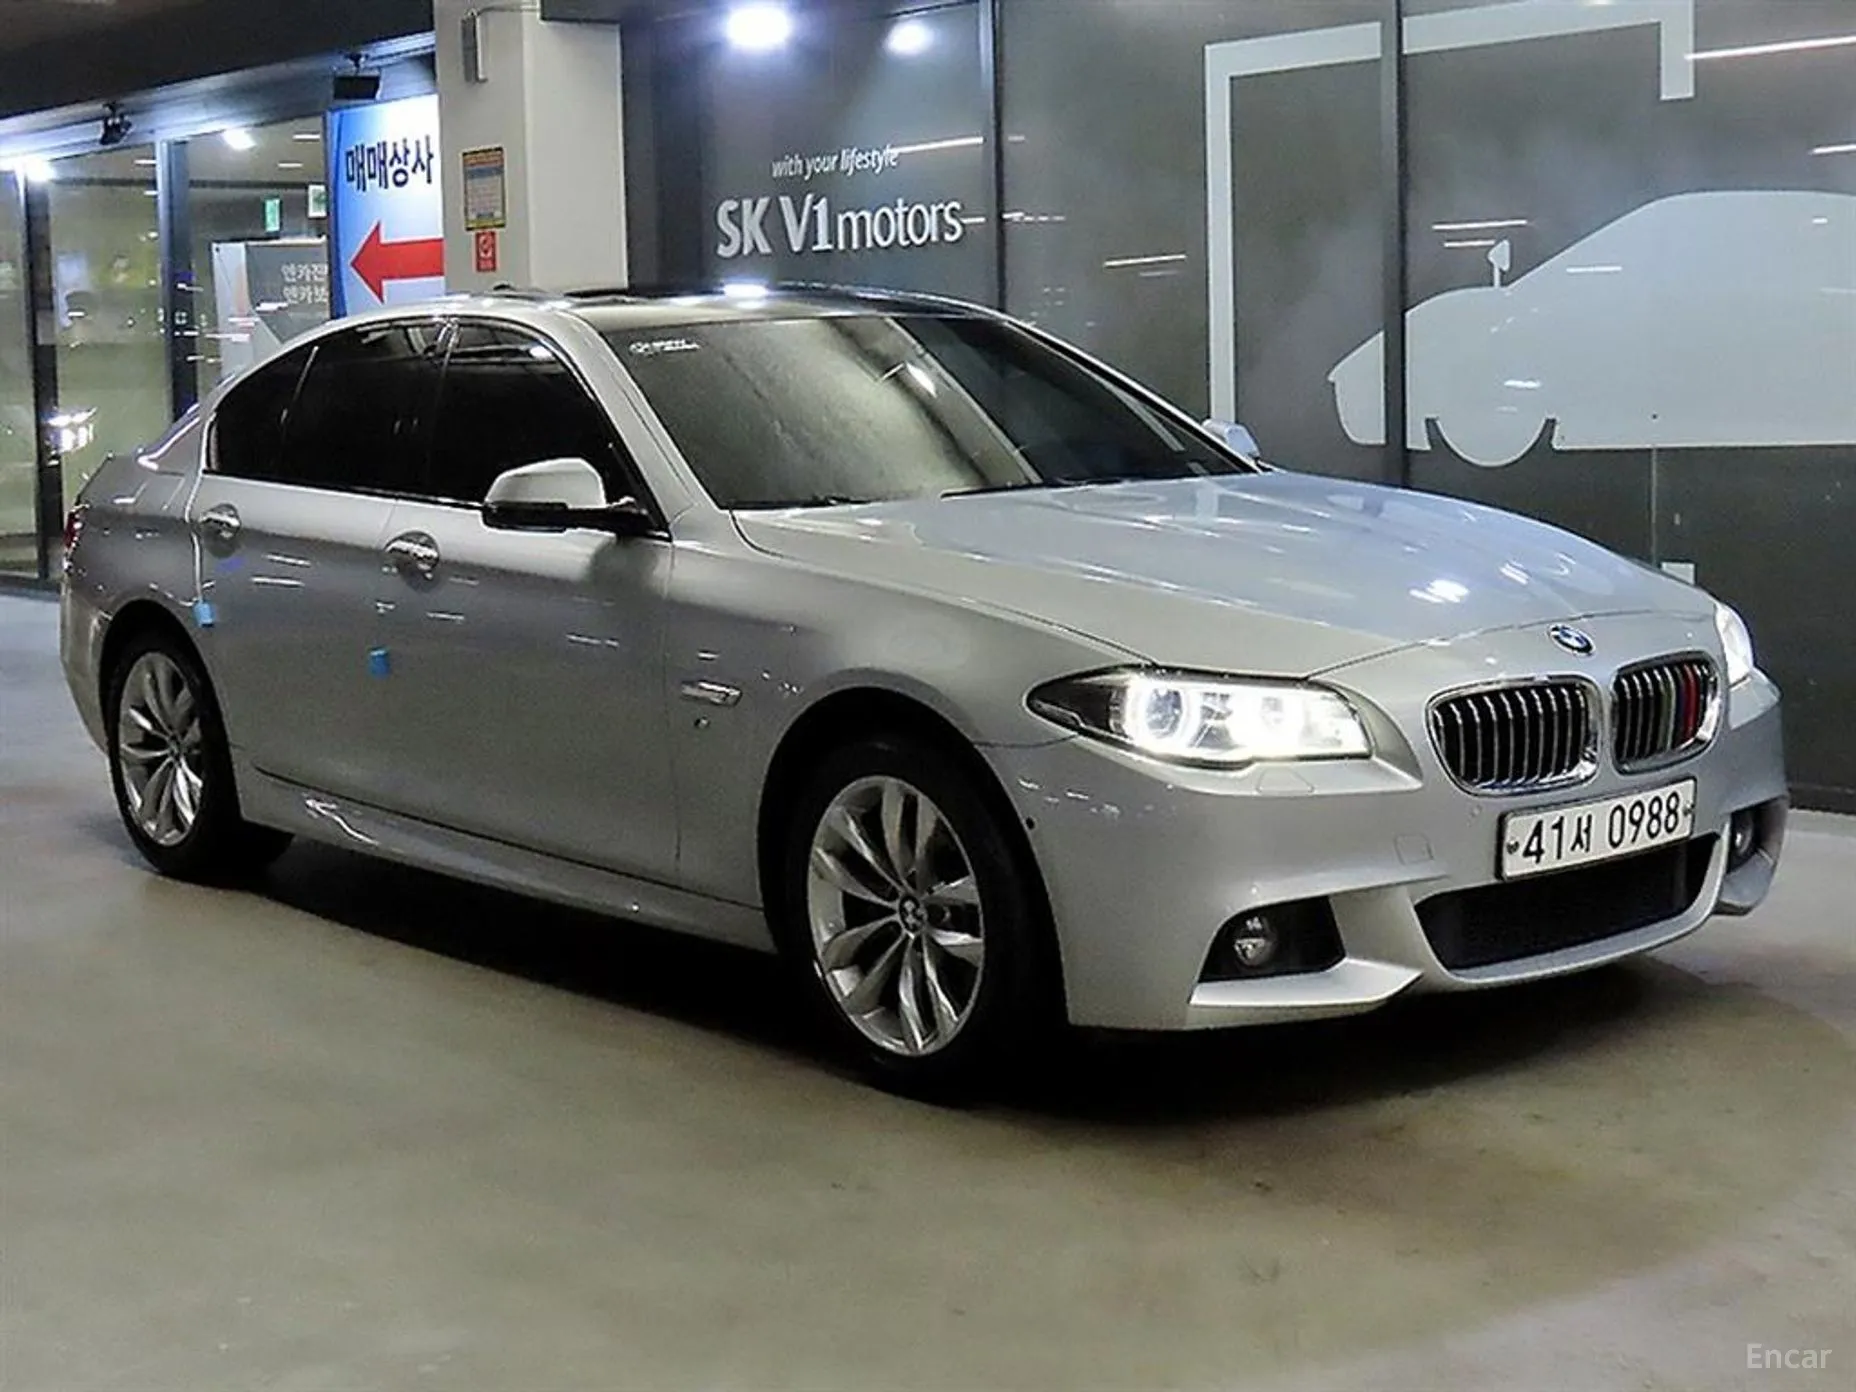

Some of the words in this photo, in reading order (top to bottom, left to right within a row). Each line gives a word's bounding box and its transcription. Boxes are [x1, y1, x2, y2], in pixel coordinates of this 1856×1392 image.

[345, 134, 434, 192] 매매상사
[771, 153, 803, 178] with
[803, 154, 838, 181] your
[840, 144, 899, 176] lifestyle
[716, 196, 773, 258] SK
[1522, 814, 1593, 864] 41서
[1608, 791, 1680, 849] 0988
